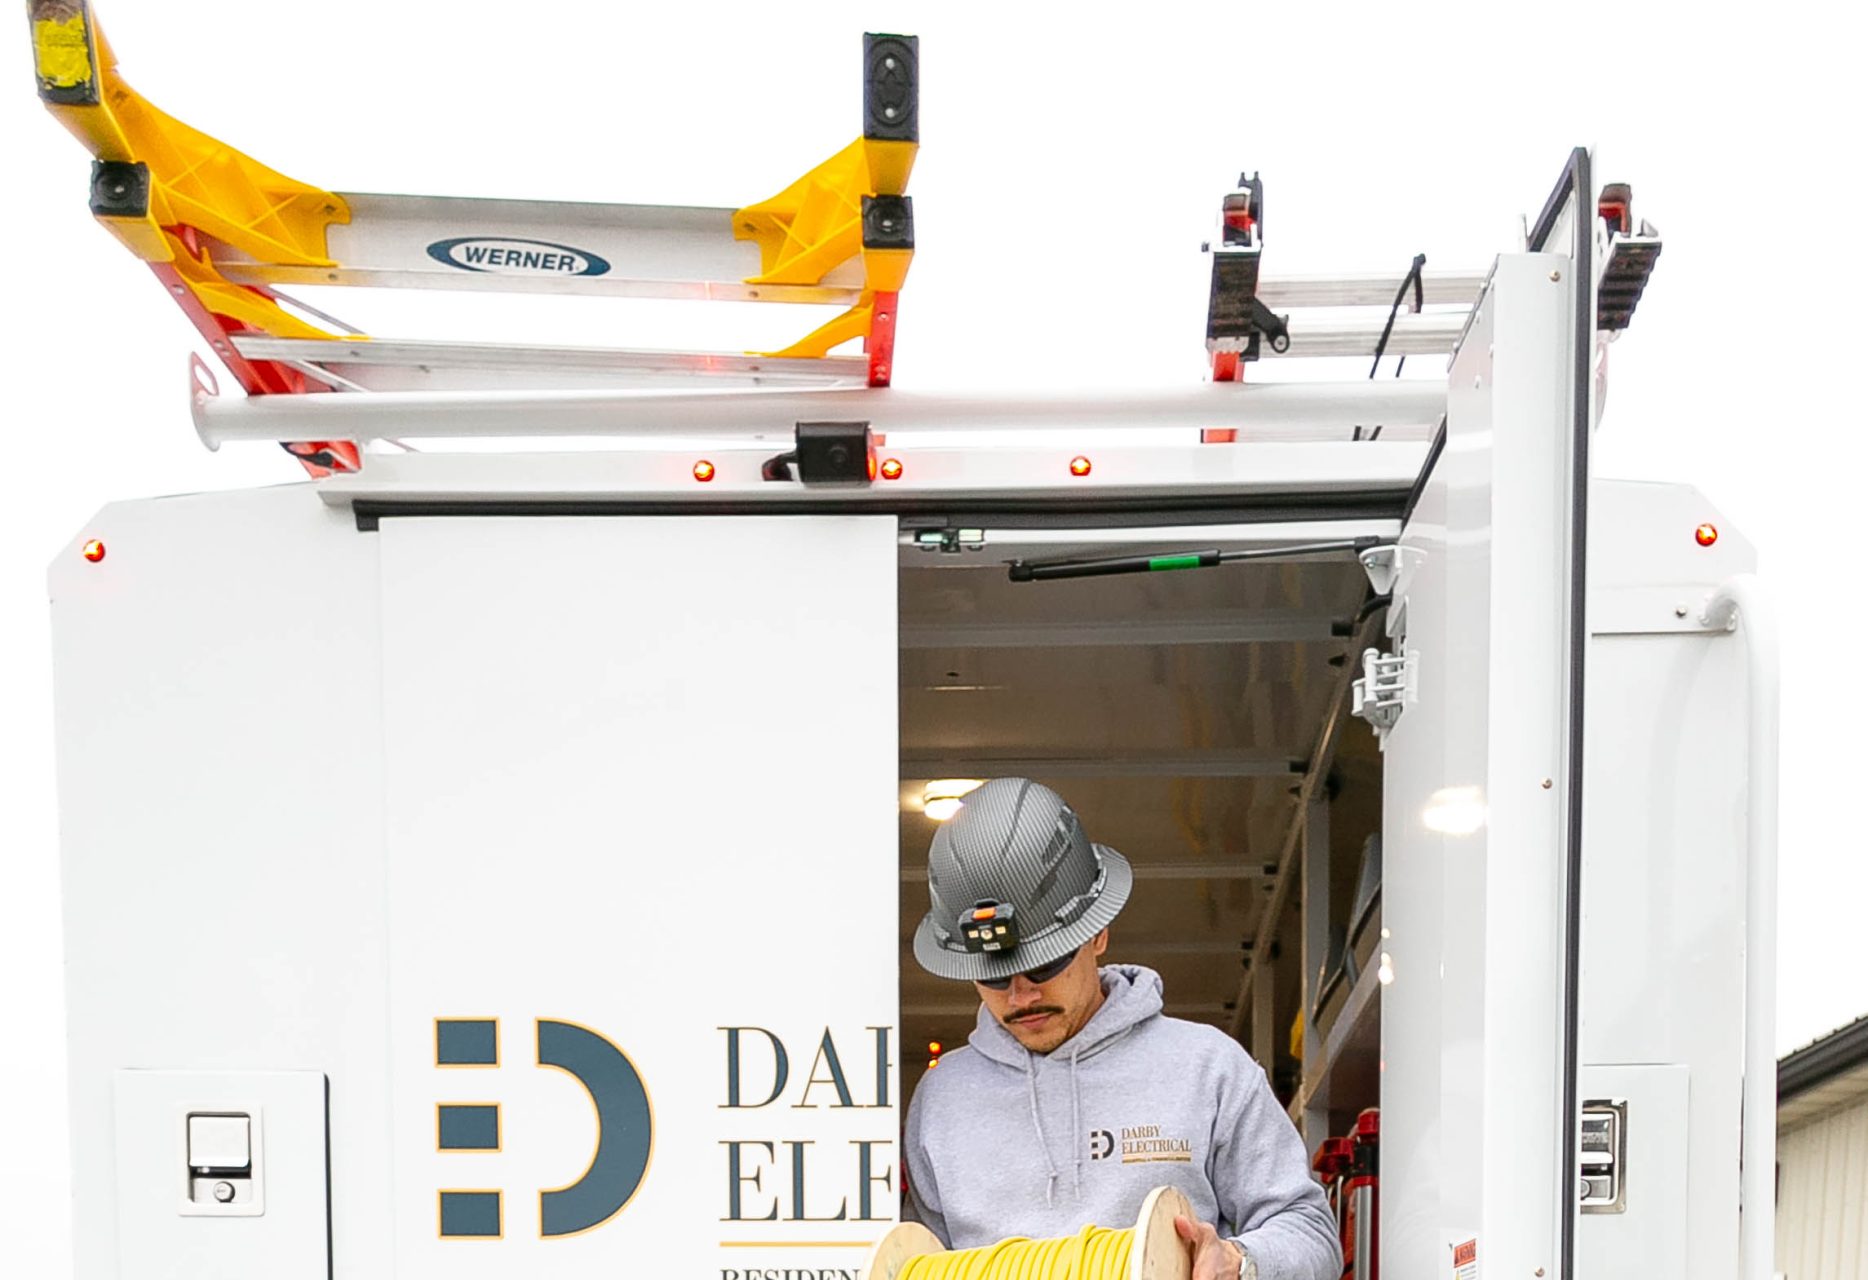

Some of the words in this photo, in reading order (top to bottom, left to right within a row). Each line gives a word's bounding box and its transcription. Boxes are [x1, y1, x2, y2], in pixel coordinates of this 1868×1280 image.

[465, 246, 575, 271] WERNER
[1121, 1125, 1161, 1140] DARBY
[1121, 1140, 1192, 1155] ELECTRICAL
